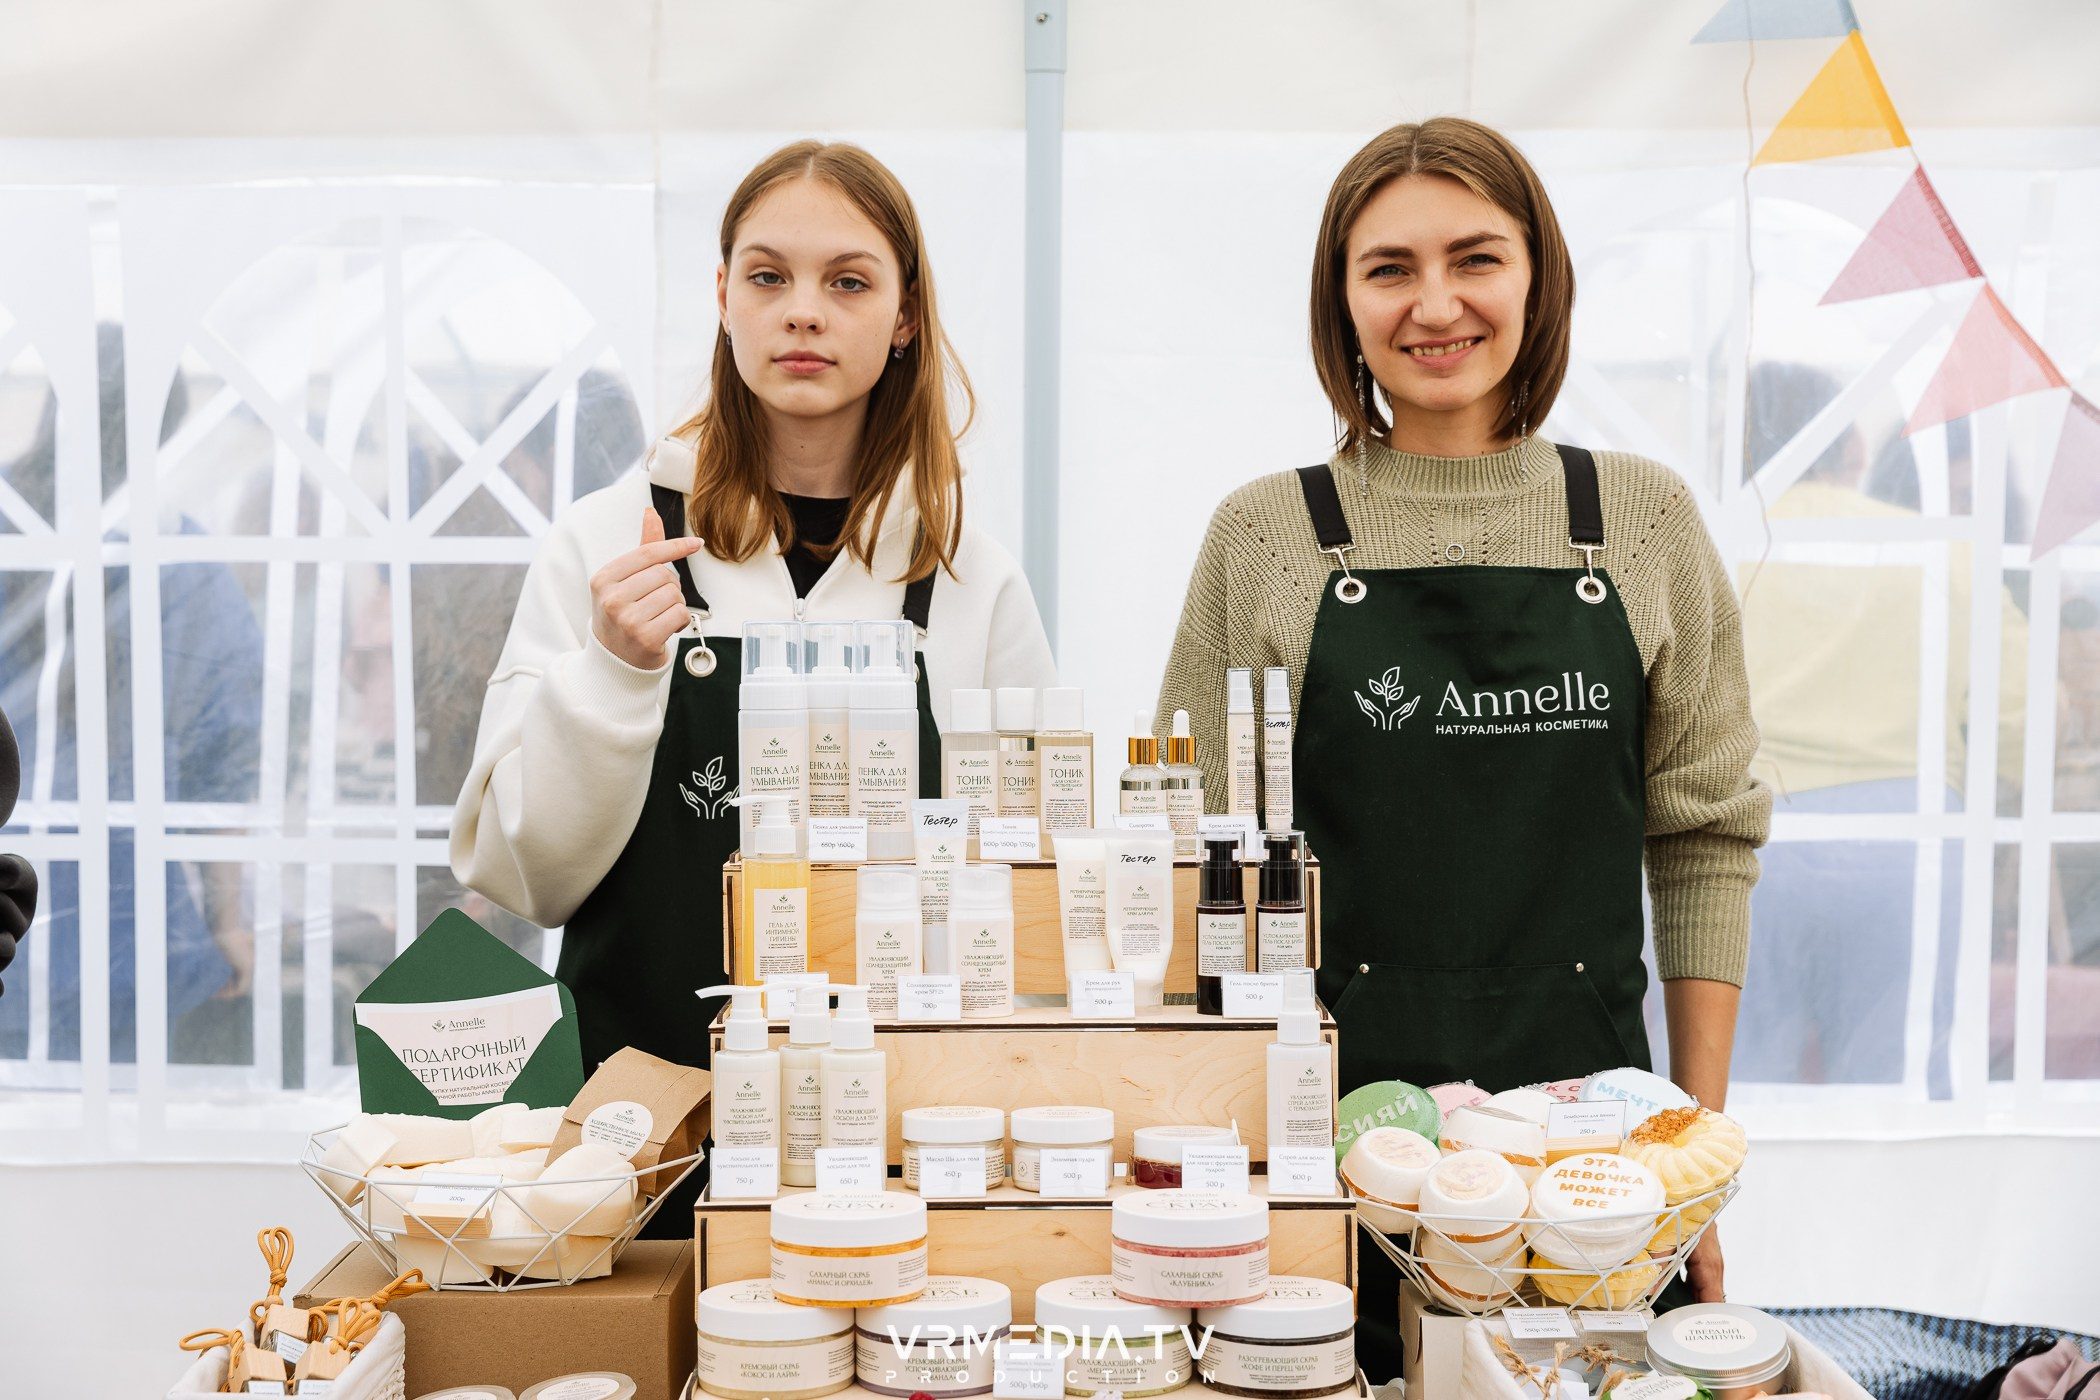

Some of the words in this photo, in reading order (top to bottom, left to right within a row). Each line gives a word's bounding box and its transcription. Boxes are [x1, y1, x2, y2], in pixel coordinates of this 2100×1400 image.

[1436, 671, 1611, 717] Annelle
[1436, 722, 1531, 735] НАТУРАЛЬНАЯ
[1535, 718, 1609, 732] КОСМЕТИКА
[750, 766, 778, 775] ПЕНКА
[781, 765, 799, 775] ДЛЯ
[810, 762, 833, 770] ЕНКА
[834, 762, 850, 770] ДЛ
[810, 772, 850, 780] МЫВАНИ
[858, 767, 887, 776] ПЕНКА
[888, 768, 907, 776] ДЛЯ
[1049, 768, 1085, 778] ТОНИК
[751, 776, 799, 786] УМЫВАНИЯ
[858, 778, 907, 787] УМЫВАНИЯ
[956, 776, 992, 785] ТОНИК
[923, 814, 958, 828] Тестер
[1120, 854, 1156, 864] Тестер
[448, 1017, 486, 1029] Annelle
[402, 1036, 526, 1063] ПОДАРОЧНЫЙ
[450, 1083, 489, 1093] НАТУРАЛЬНОЙ
[490, 1080, 513, 1088] КОСМЕТ
[1596, 1081, 1662, 1112] МЕЧТ
[1334, 1087, 1418, 1143] СИЯЙ
[1582, 1156, 1619, 1170] ЭТА
[1553, 1167, 1646, 1186] ДЕВОЧКА
[1559, 1182, 1633, 1198] МОЖЕТ
[1572, 1197, 1609, 1210] ВСЕ
[809, 1270, 848, 1279] САХАРНЫЙ
[849, 1270, 871, 1279] СКРАБ
[1160, 1270, 1200, 1280] САХАРНЫЙ
[1201, 1270, 1224, 1280] СКРАБ
[1169, 1279, 1216, 1288] «КЛУБНИКА»
[907, 1357, 945, 1365] КРЕМОВЫЙ
[1076, 1358, 1136, 1367] ОХЛАЖДАЮЩИЙ
[1238, 1354, 1299, 1364] РАЗОГРЕВАЮЩИЙ
[740, 1362, 778, 1371] КРЕМОВЫЙ
[740, 1370, 766, 1379] «КОКОС
[767, 1370, 773, 1379] И
